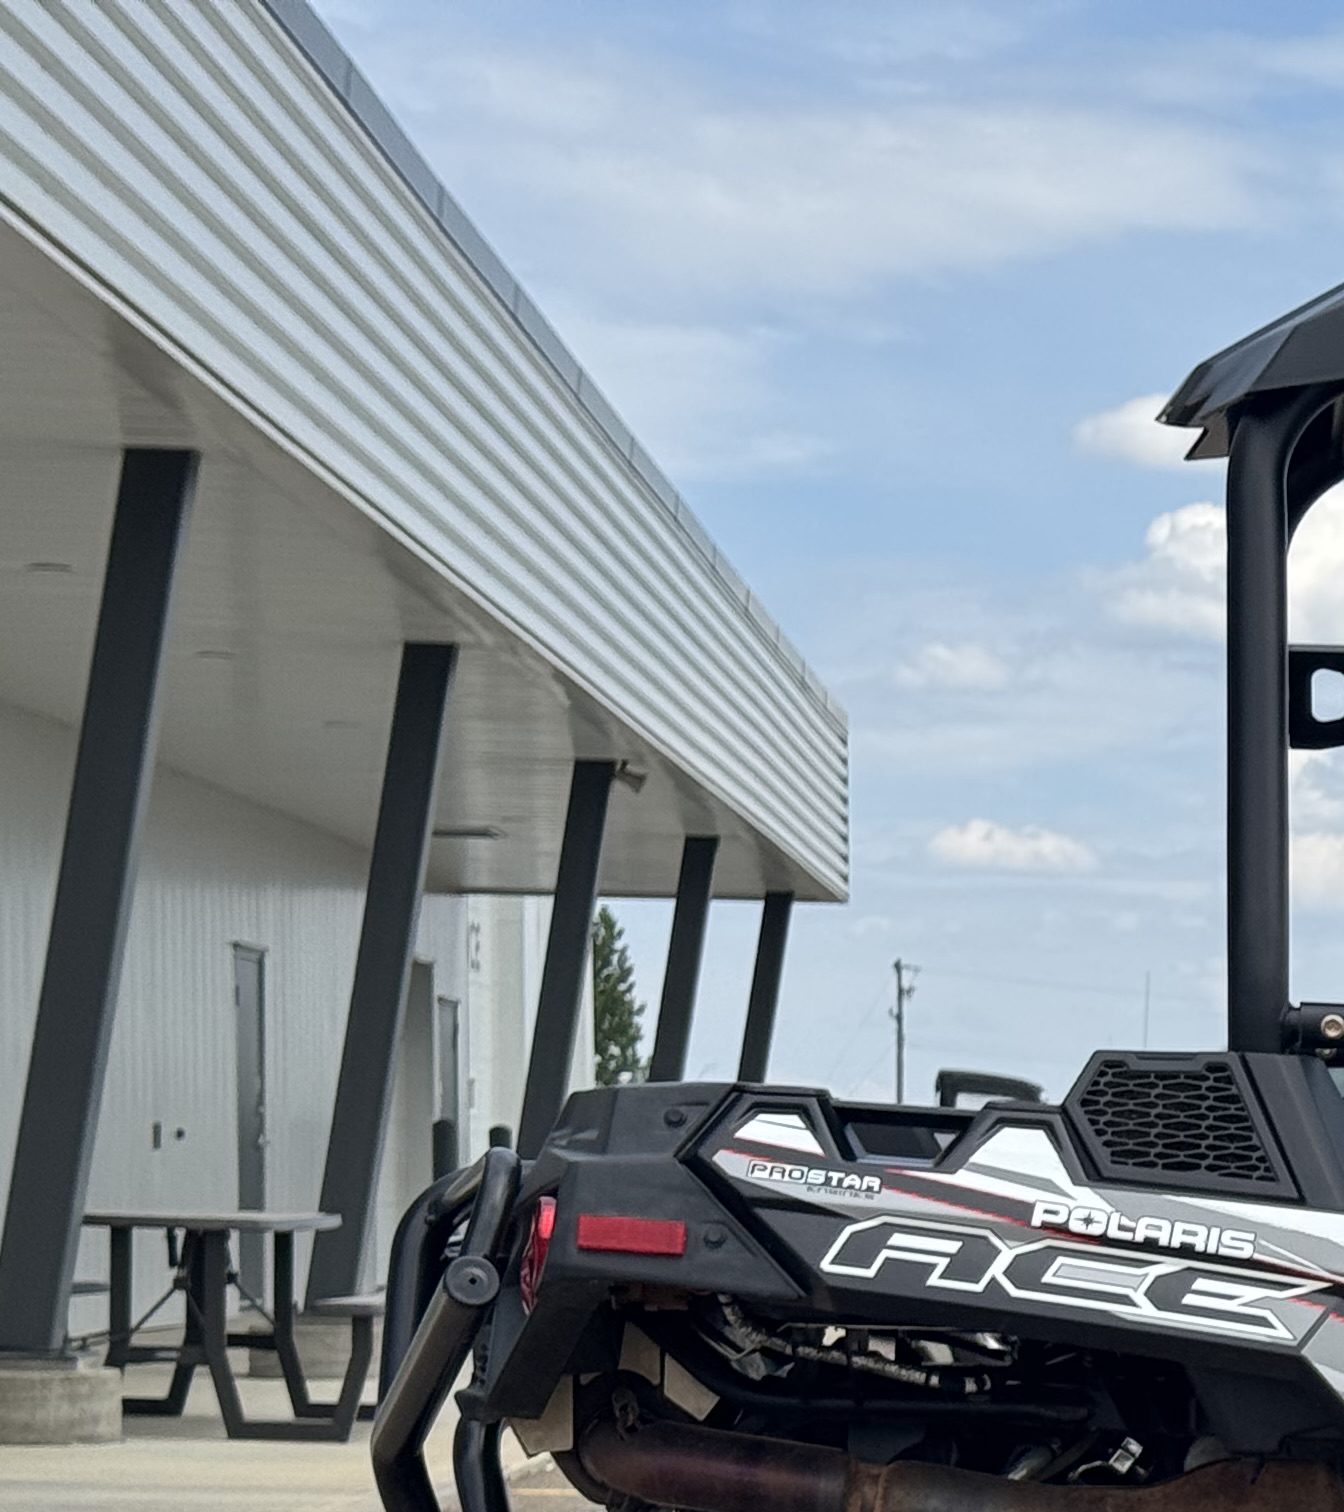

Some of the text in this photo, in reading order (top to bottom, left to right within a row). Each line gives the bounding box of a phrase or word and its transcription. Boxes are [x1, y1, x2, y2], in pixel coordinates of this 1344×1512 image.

[748, 1160, 882, 1194] PROSTAR
[1031, 1200, 1257, 1261] POLARIS
[819, 1214, 1335, 1341] ACE
